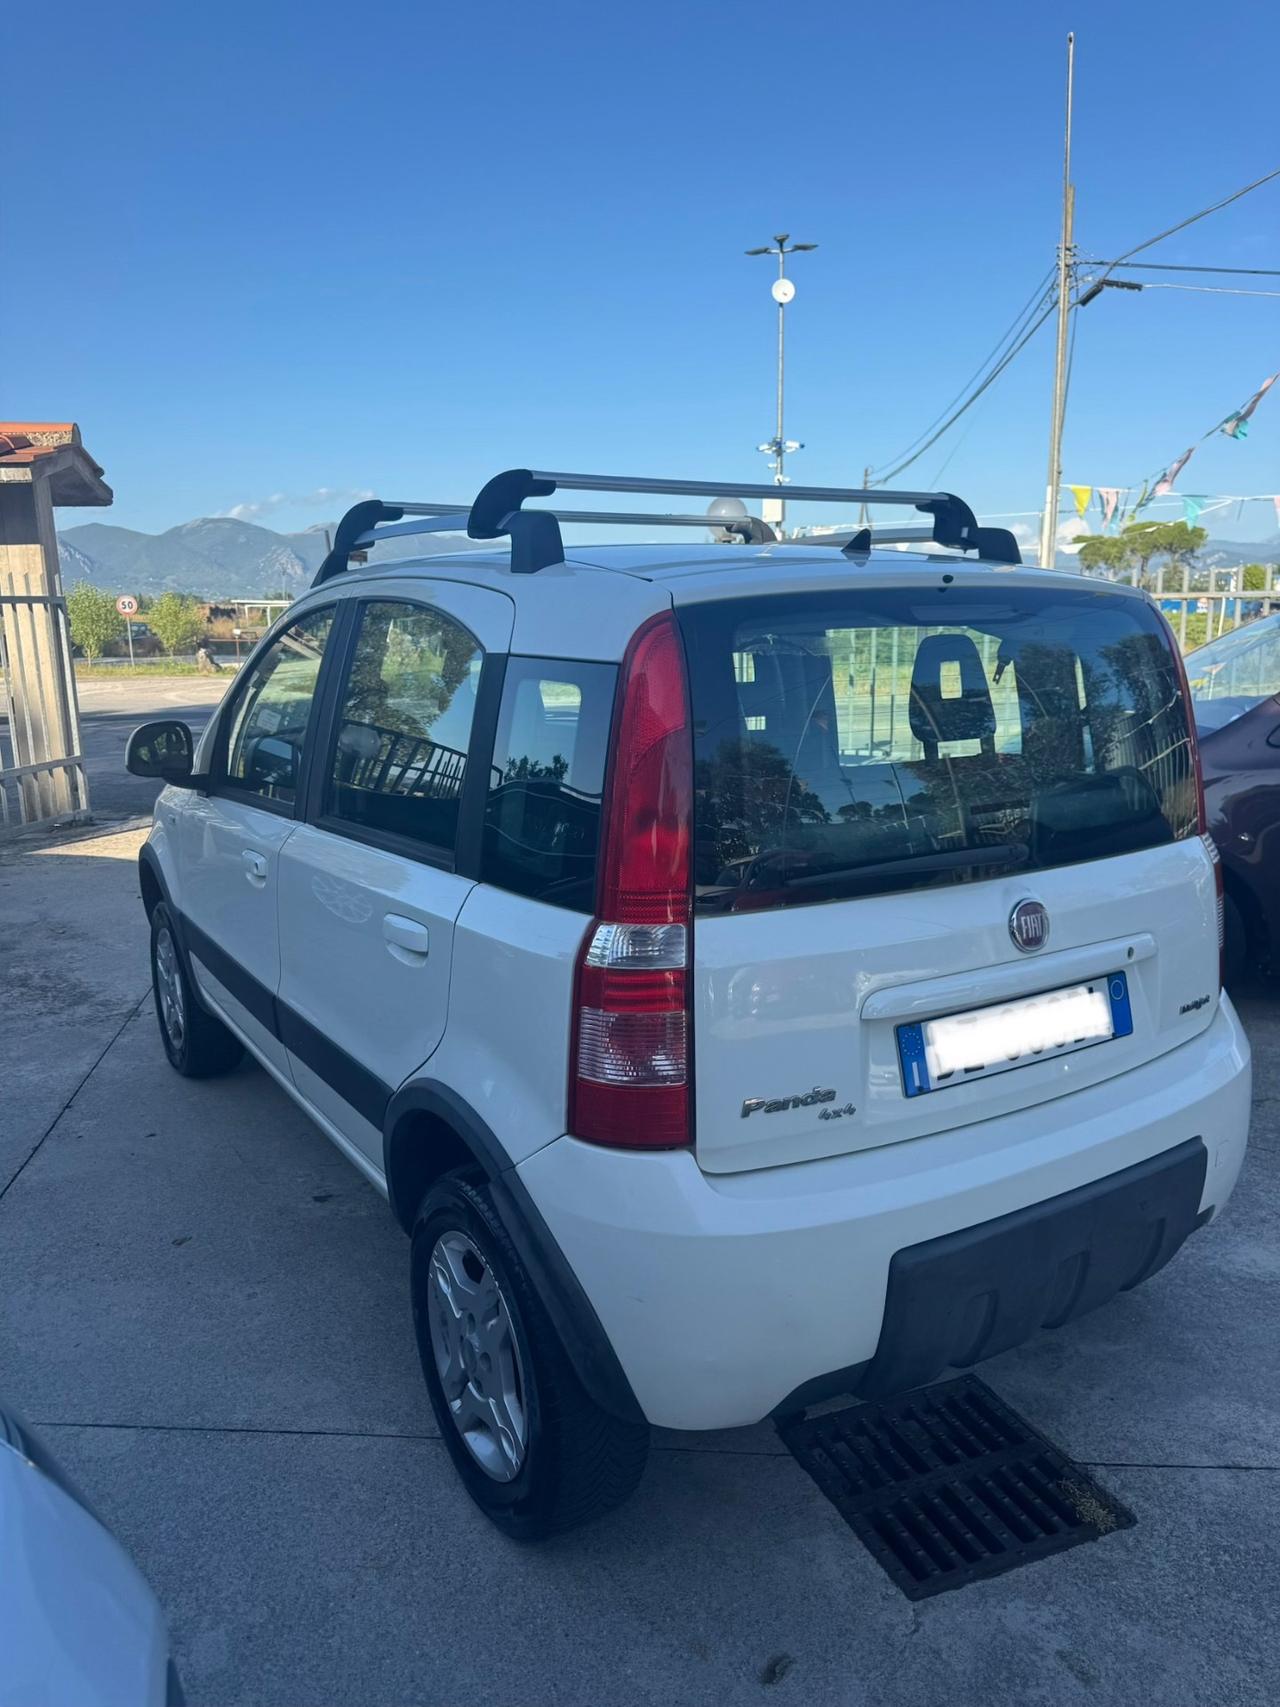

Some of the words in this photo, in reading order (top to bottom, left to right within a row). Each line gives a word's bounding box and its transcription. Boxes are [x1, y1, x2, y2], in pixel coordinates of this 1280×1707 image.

[121, 601, 133, 609] 50
[1021, 913, 1042, 939] FIAT
[741, 1086, 836, 1118] Panda
[818, 1103, 856, 1120] 4x4
